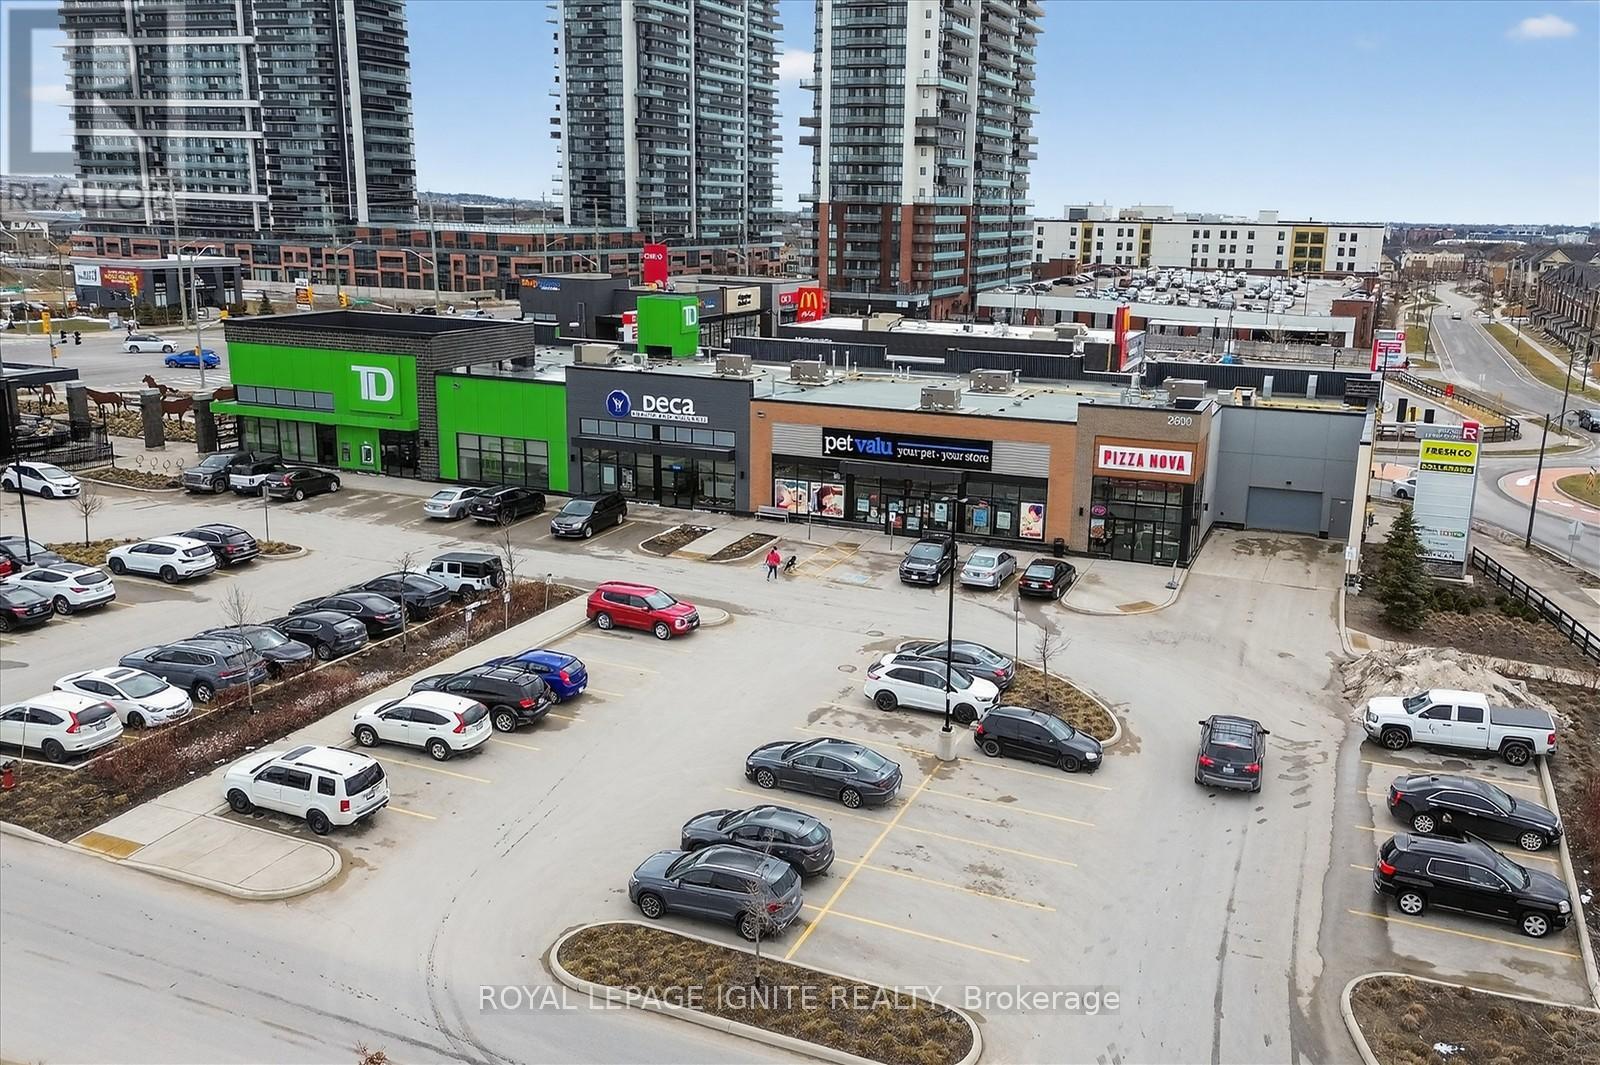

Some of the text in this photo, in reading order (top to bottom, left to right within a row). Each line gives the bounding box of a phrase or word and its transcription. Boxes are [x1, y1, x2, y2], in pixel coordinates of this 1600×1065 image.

[683, 306, 697, 326] TD
[351, 365, 394, 402] TD
[642, 395, 695, 415] Deca
[824, 435, 893, 455] pet valu
[965, 453, 989, 463] store
[1104, 450, 1185, 471] PIZZA NOVA
